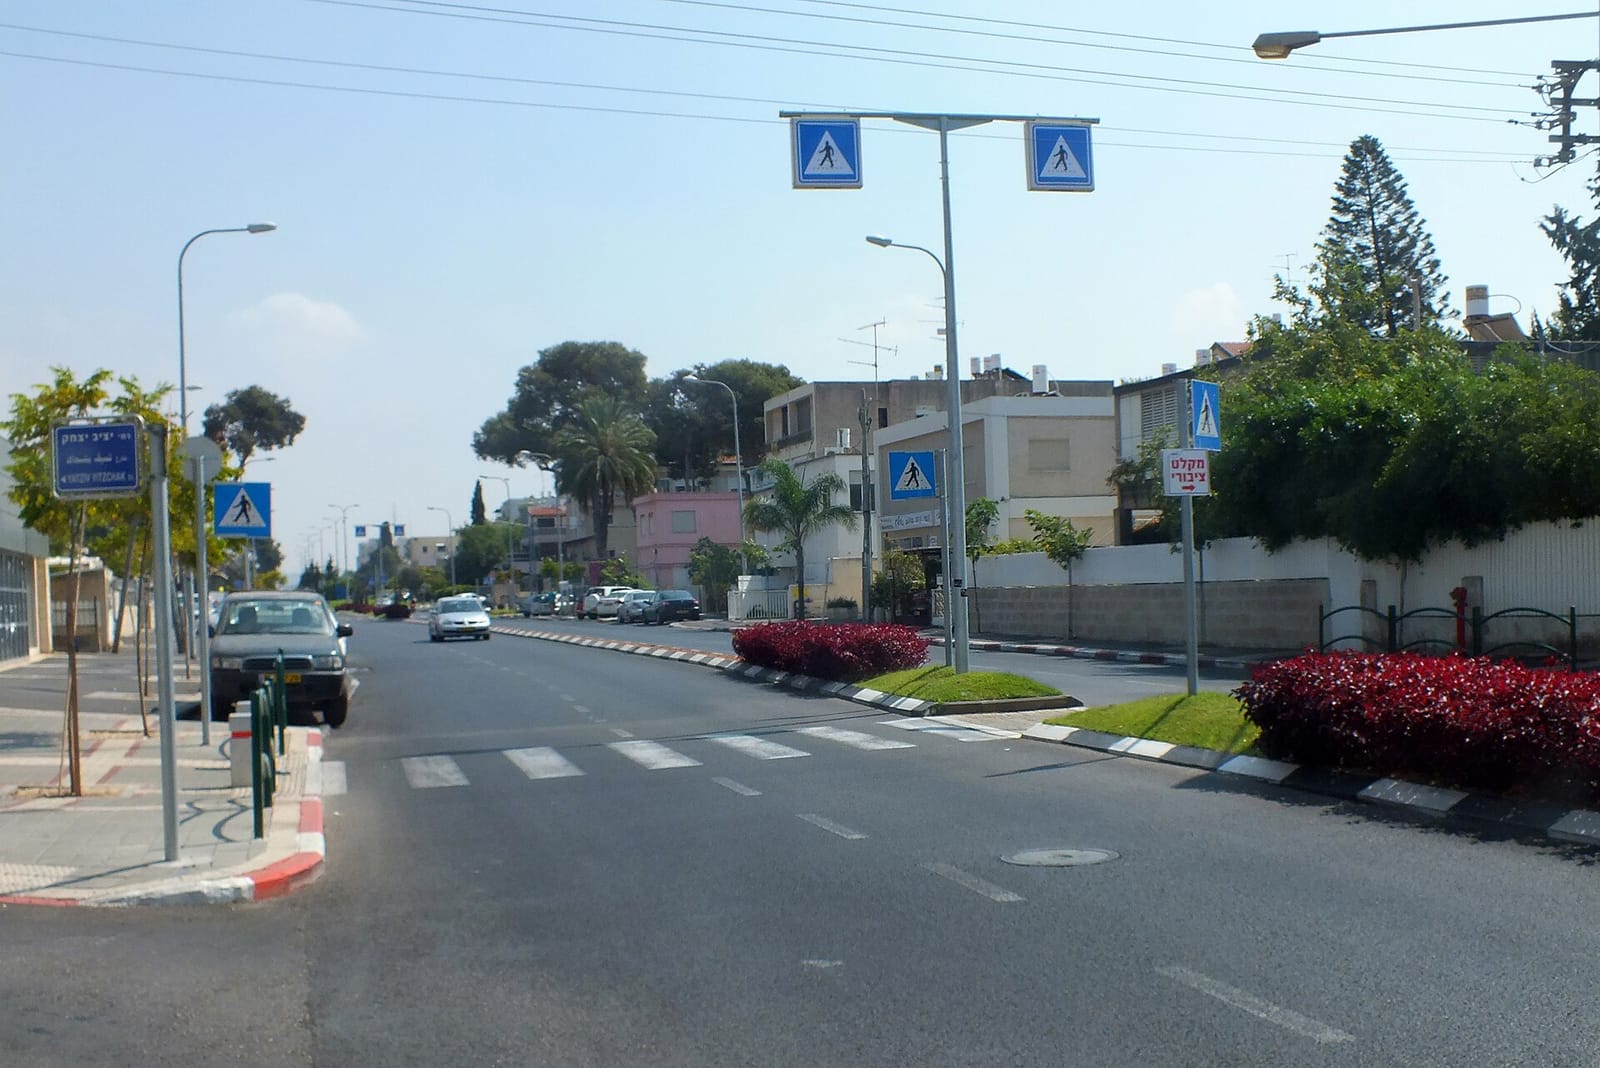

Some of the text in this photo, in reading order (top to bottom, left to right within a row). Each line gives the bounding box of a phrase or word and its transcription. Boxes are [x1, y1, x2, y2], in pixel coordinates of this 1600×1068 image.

[62, 433, 89, 445] יצחק
[1171, 457, 1205, 471] מקלט
[1171, 473, 1206, 482] ציבורי
